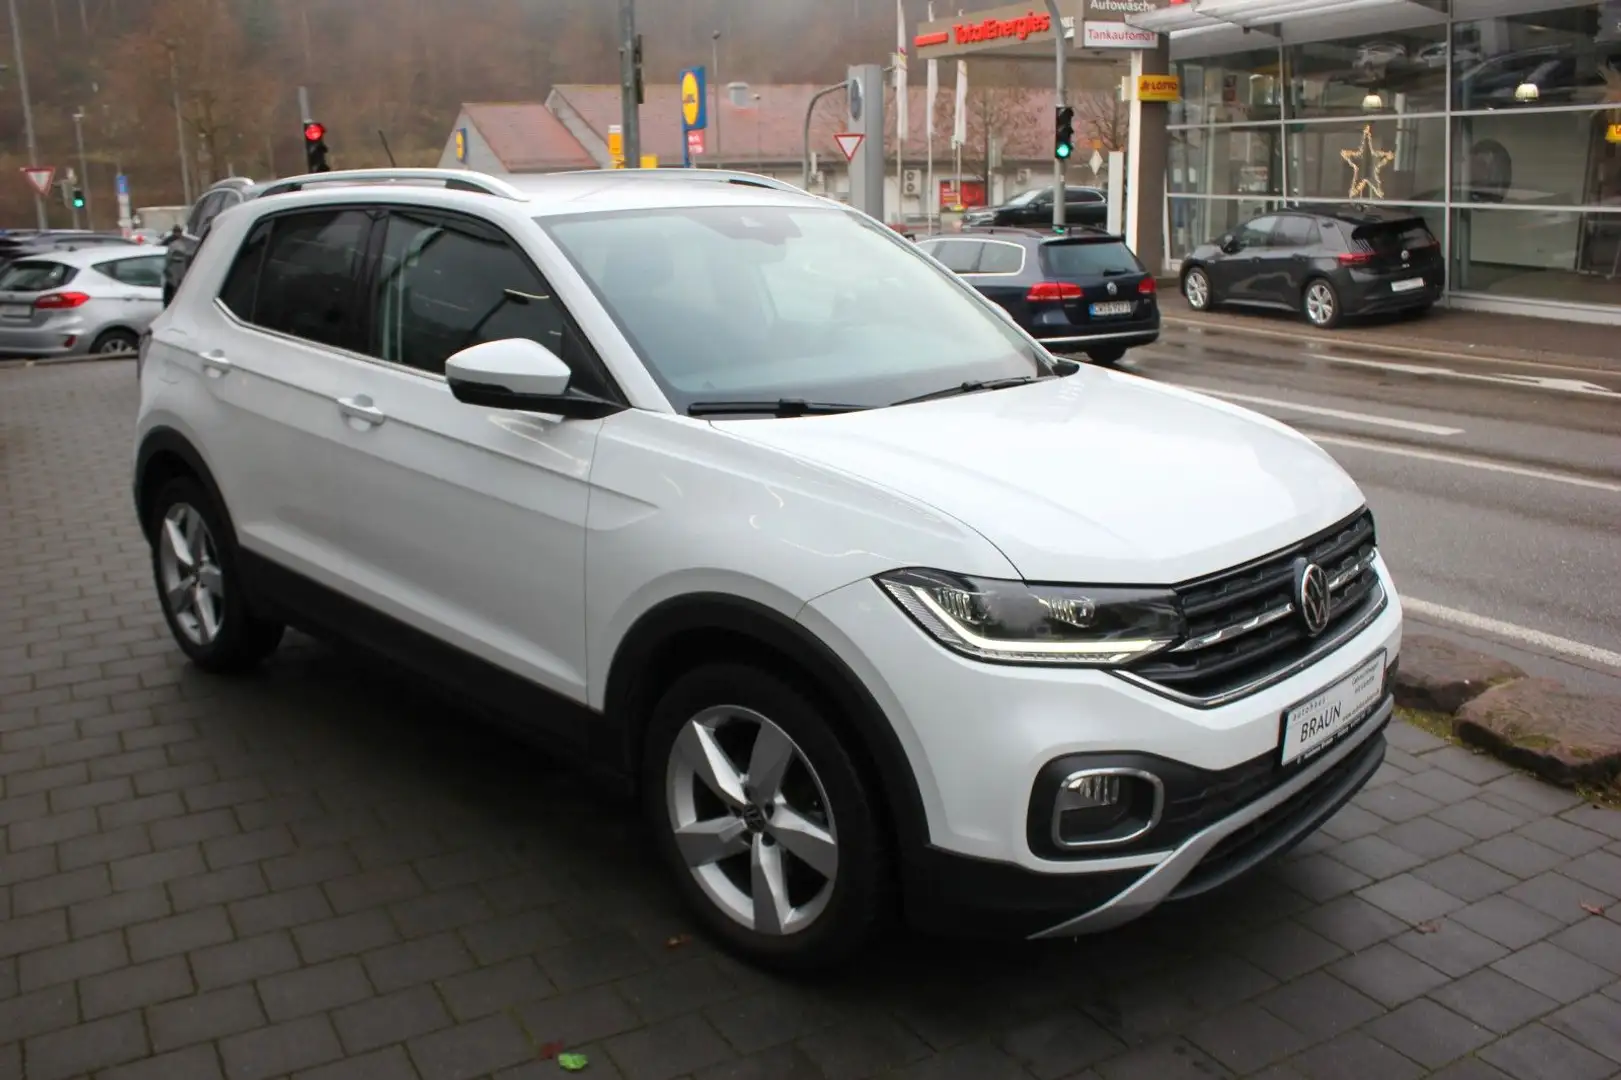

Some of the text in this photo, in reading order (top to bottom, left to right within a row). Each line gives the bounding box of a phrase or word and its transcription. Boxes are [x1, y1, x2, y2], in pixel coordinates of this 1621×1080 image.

[952, 11, 1051, 45] TotalEnergies
[1088, 28, 1156, 41] Tankautomat
[1299, 700, 1342, 743] BRAUN
